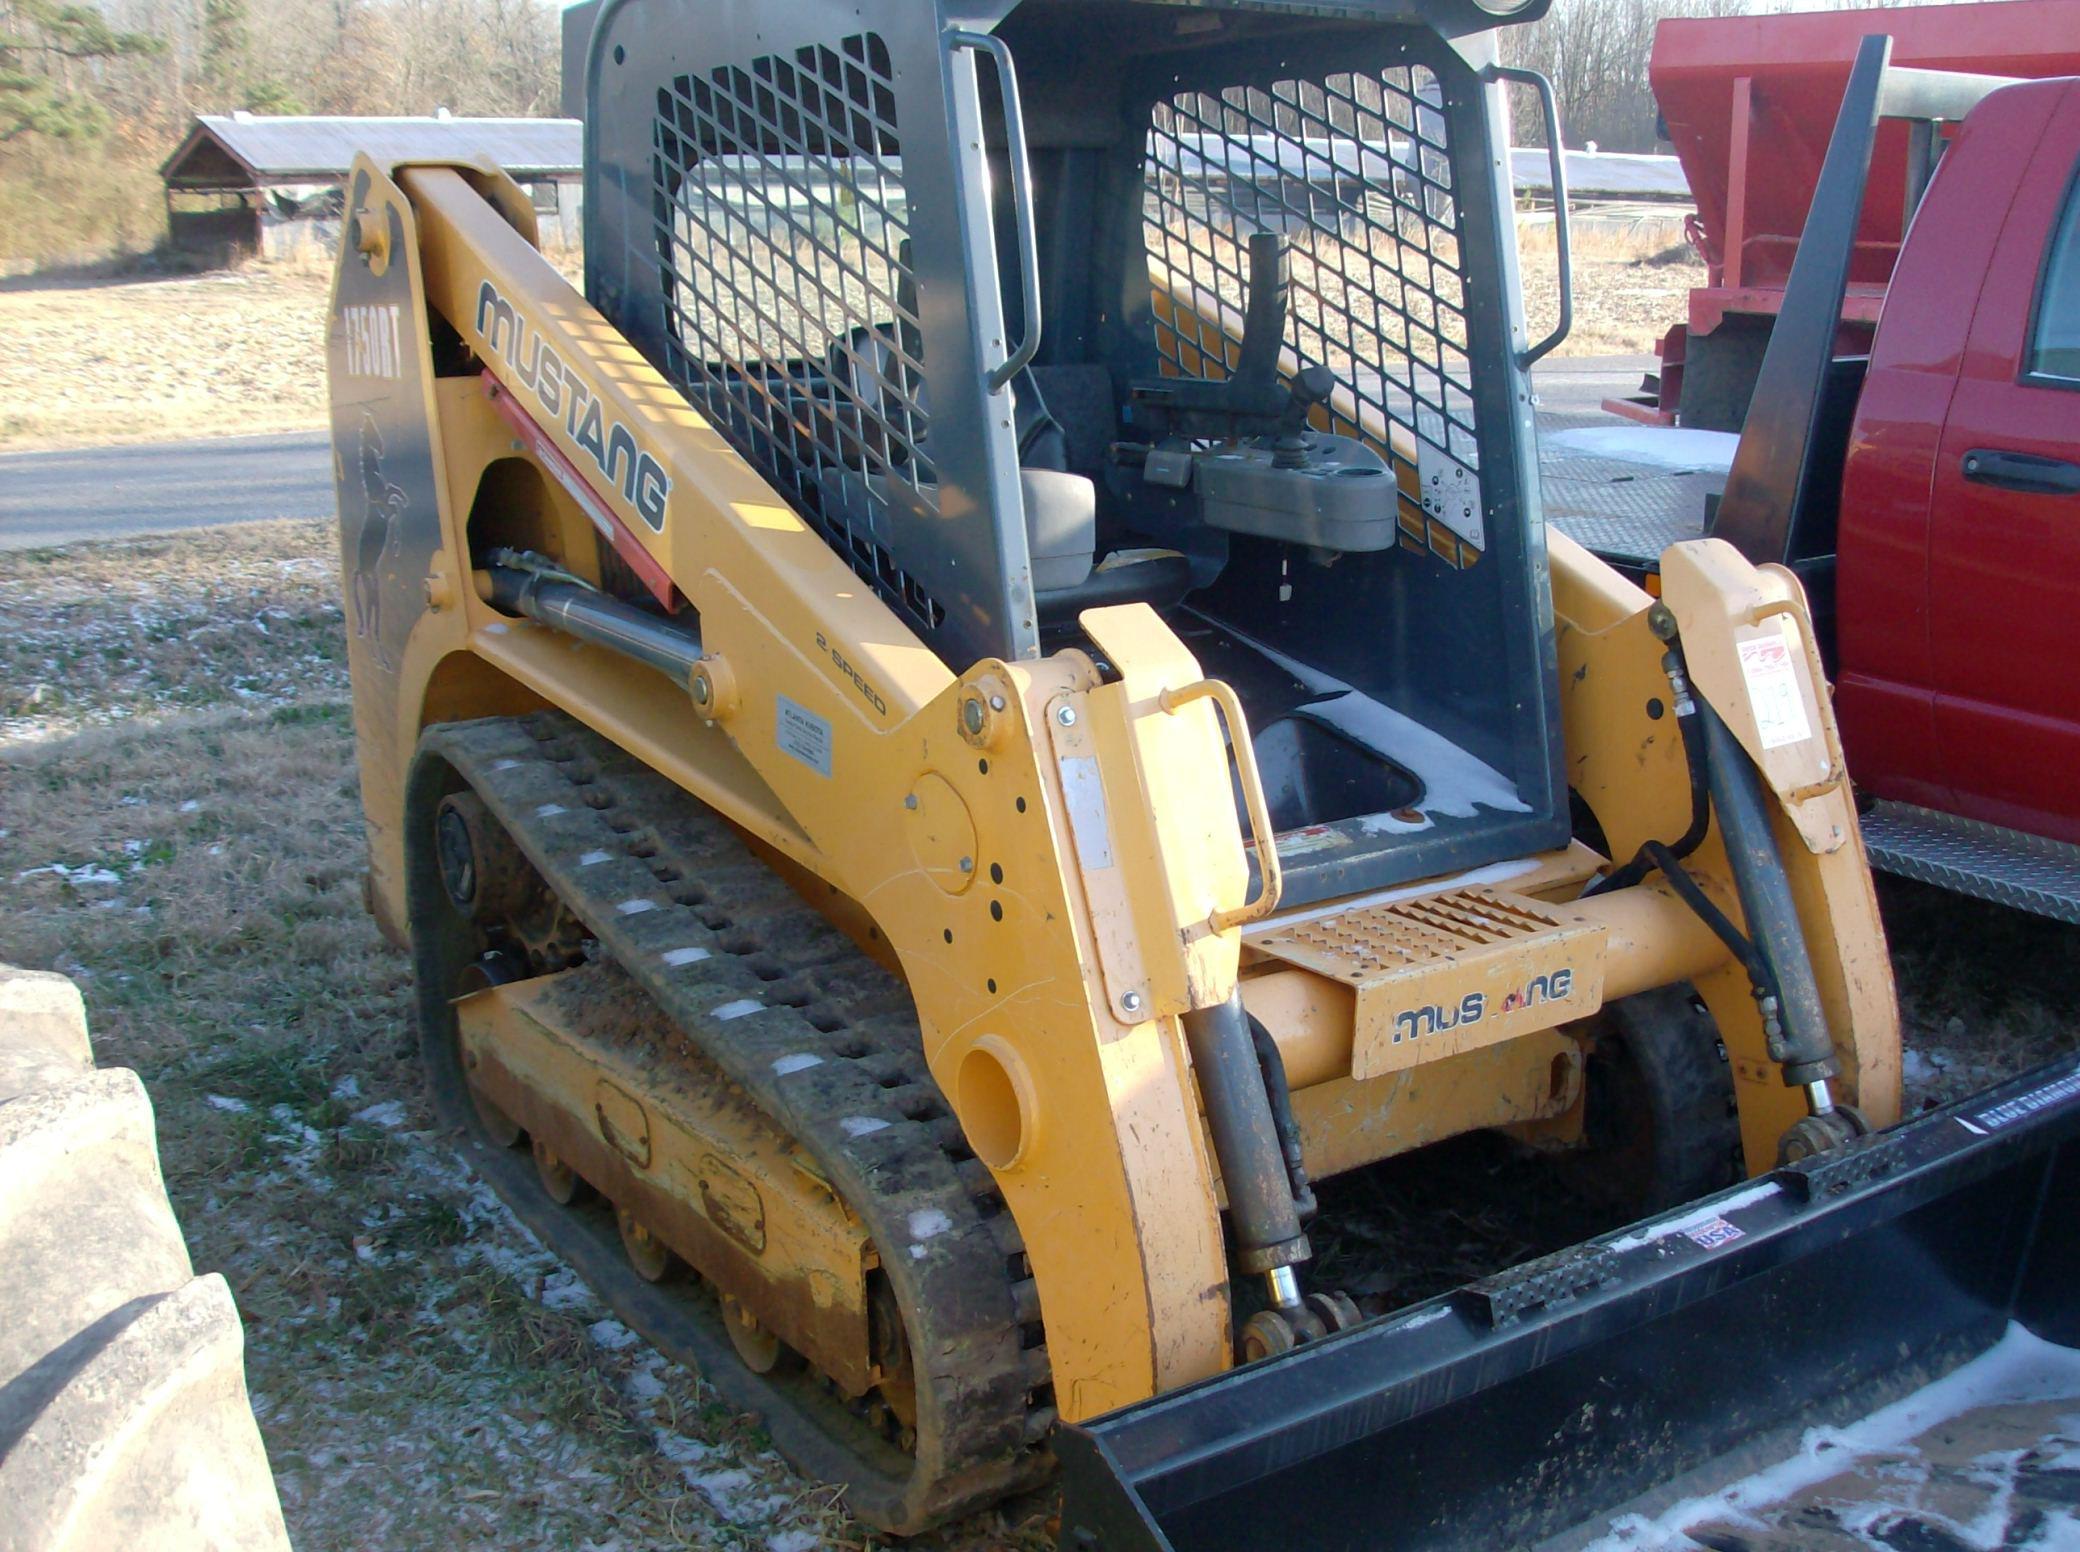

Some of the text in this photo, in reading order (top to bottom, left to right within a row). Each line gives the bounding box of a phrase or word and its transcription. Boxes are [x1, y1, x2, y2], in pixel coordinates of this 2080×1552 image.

[475, 279, 669, 534] MUSTANG
[815, 630, 887, 716] 2 SPEED
[1392, 968, 1574, 1045] MUSANG
[1974, 1100, 2028, 1128] BLUE
[1695, 1225, 1742, 1246] USA
